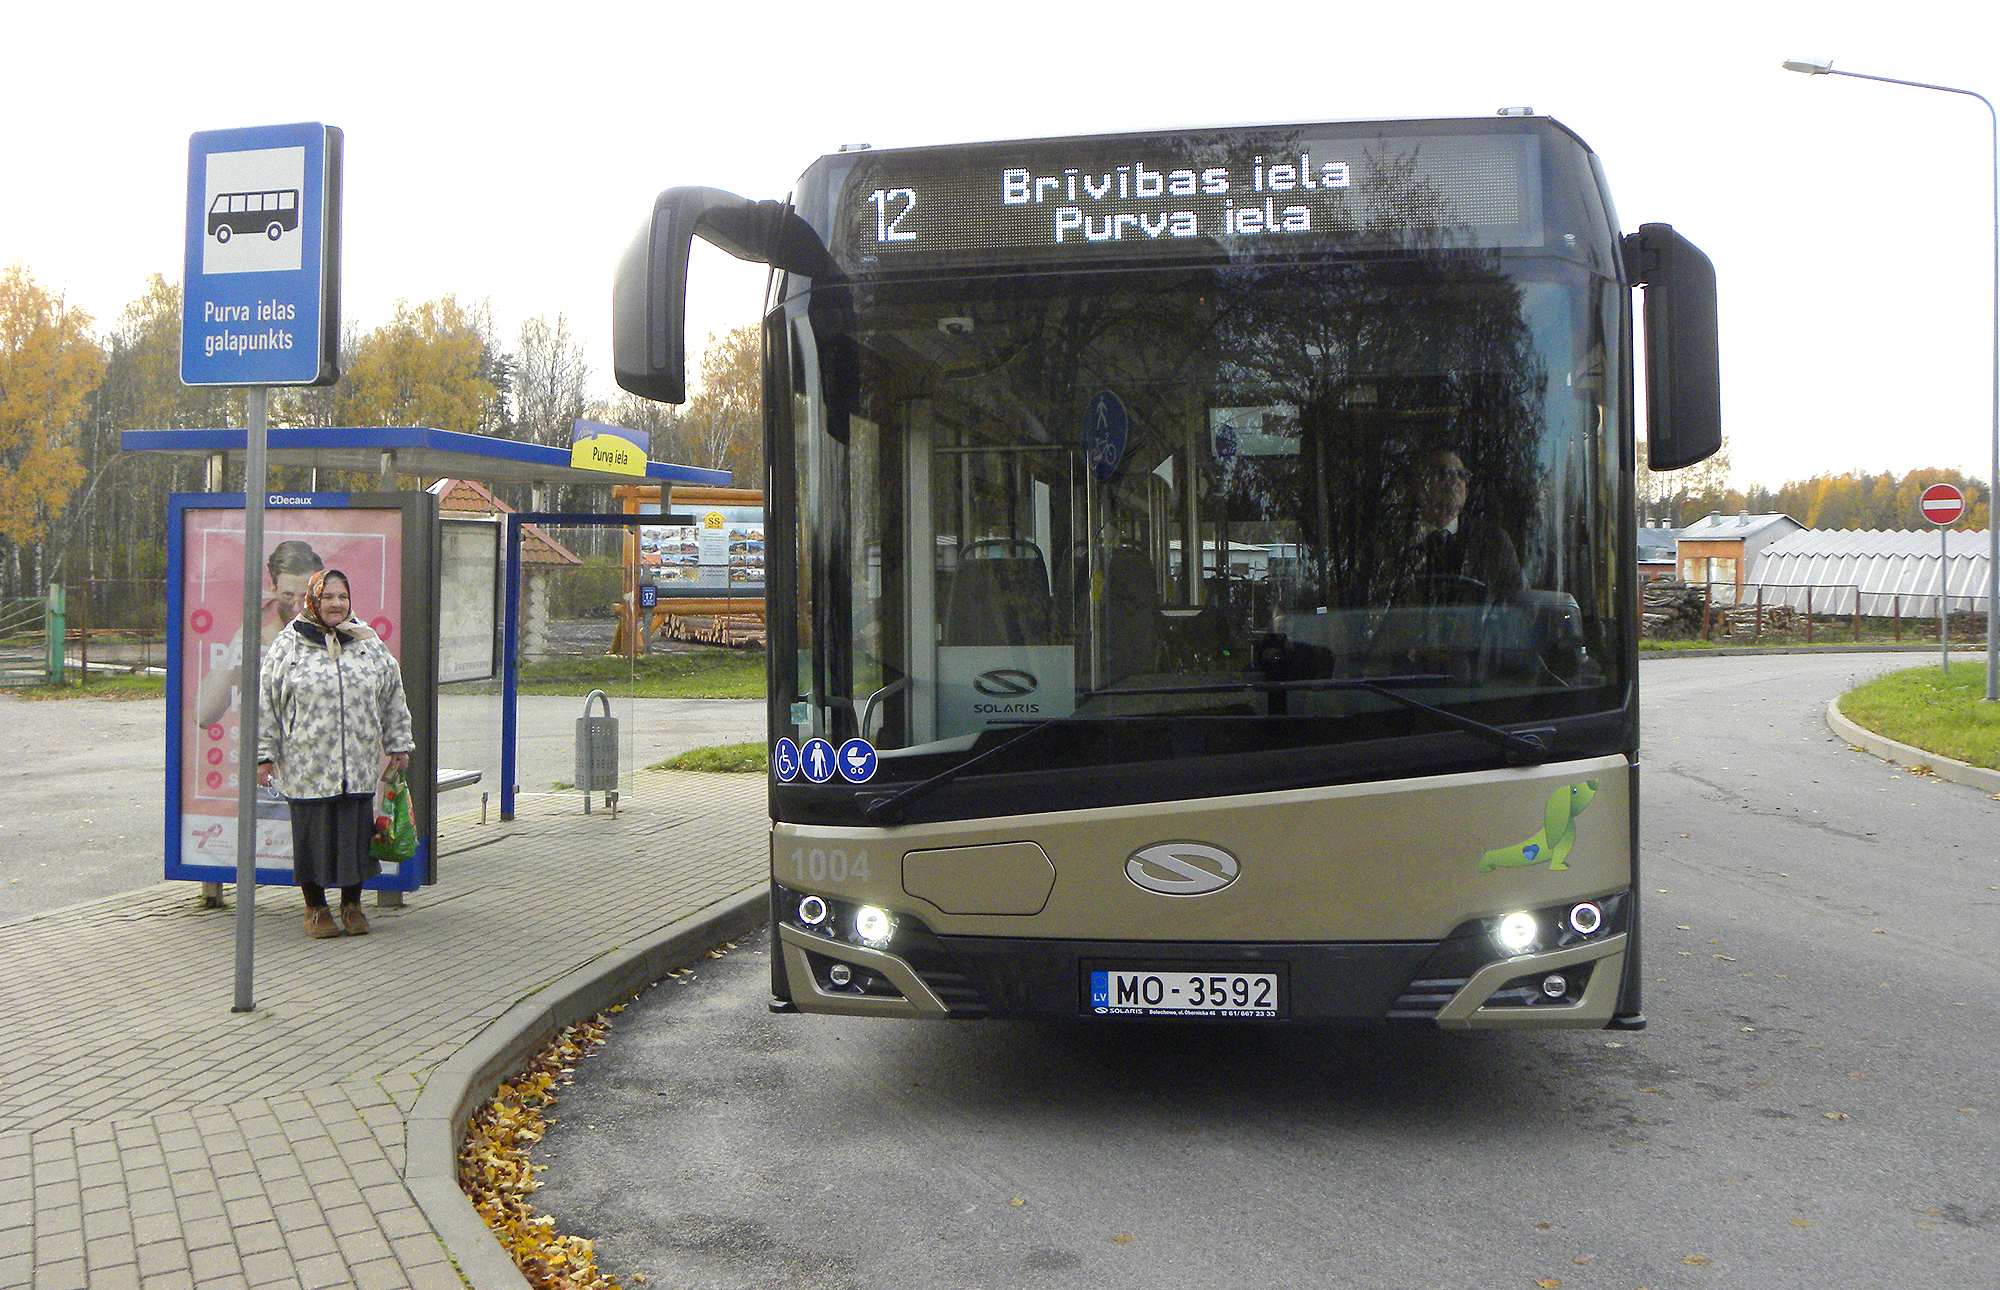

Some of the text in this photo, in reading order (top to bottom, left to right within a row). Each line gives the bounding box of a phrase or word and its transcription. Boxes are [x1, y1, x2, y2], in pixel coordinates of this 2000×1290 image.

[866, 152, 1351, 242] 12 Brīvības iela
[1054, 196, 1312, 243] Purva iela
[205, 299, 296, 322] Purva ielas
[205, 328, 293, 357] galapunkts
[592, 446, 628, 465] Purva iela
[708, 517, 721, 526] SS
[644, 592, 654, 600] 17
[973, 703, 1040, 714] SOLARIS
[792, 848, 872, 883] 1004
[1093, 993, 1107, 1002] LV
[1117, 975, 1272, 1007] MO-3592
